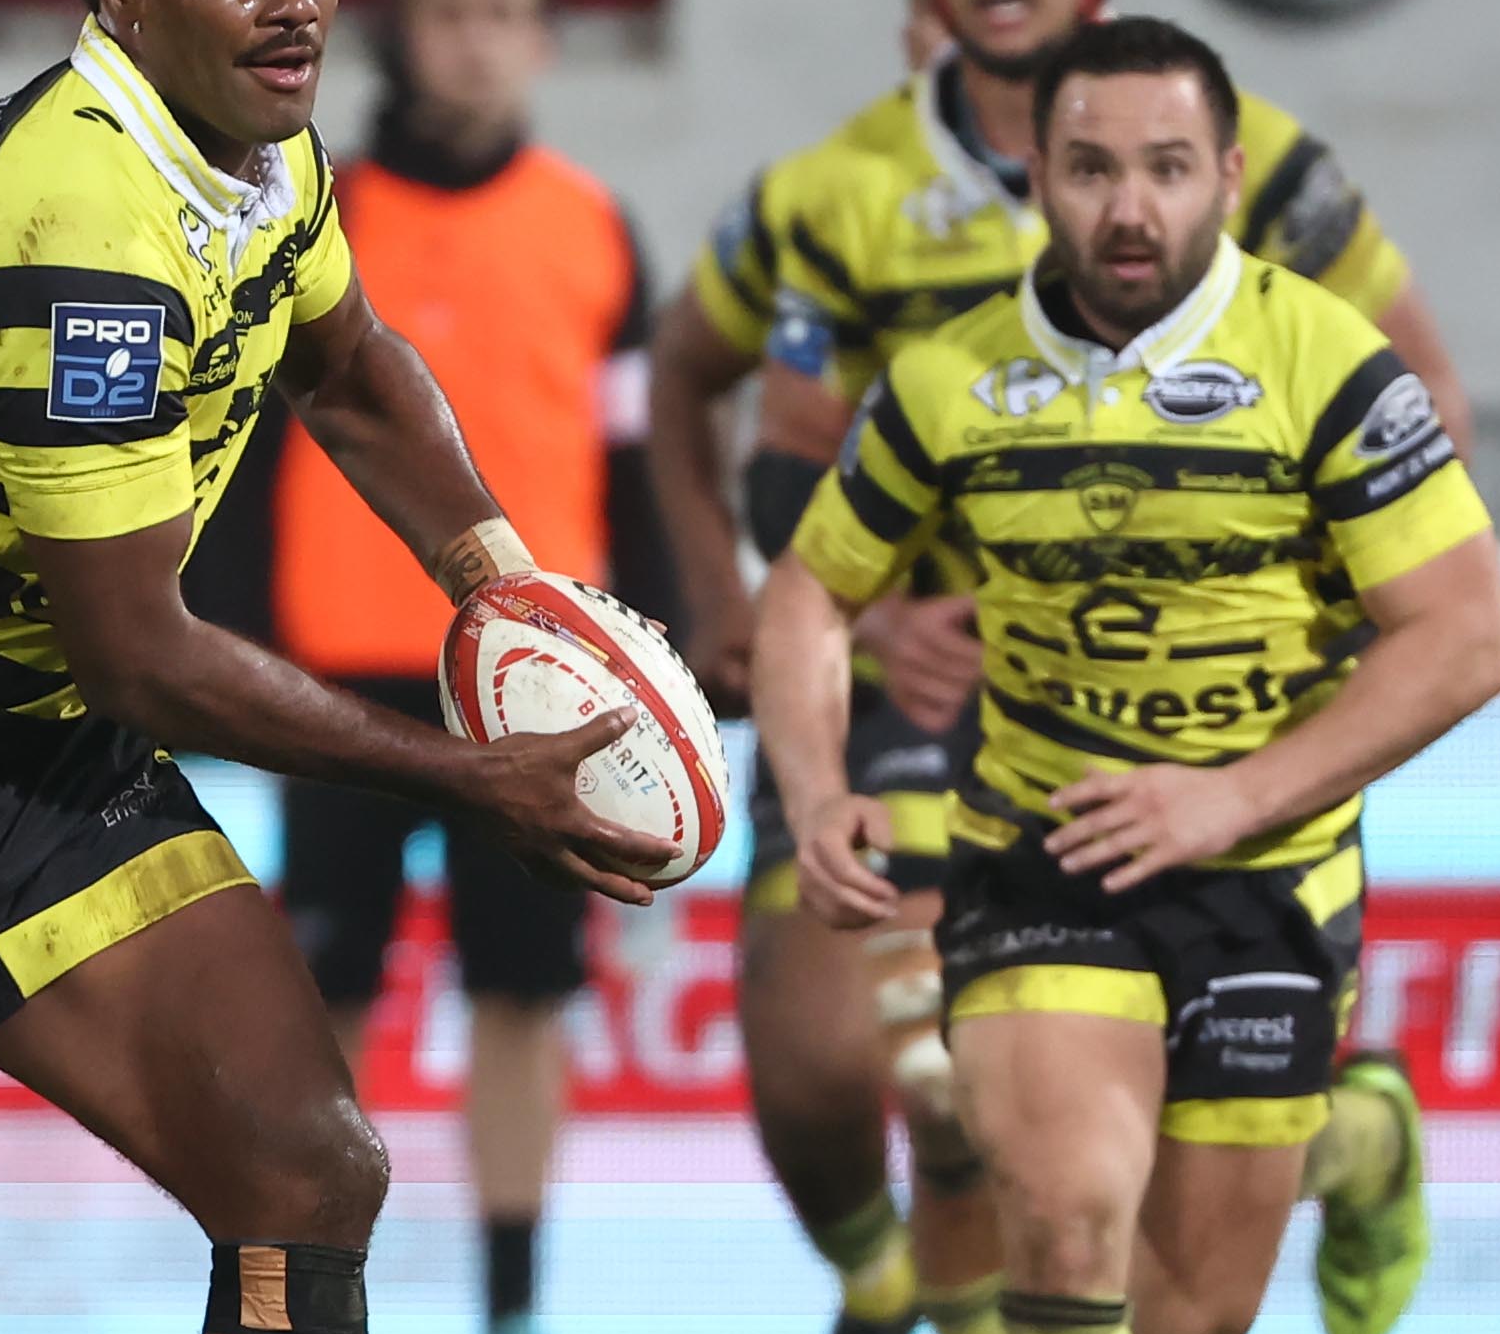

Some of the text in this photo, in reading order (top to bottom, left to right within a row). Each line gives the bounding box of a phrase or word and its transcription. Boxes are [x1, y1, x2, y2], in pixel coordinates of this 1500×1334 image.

[66, 318, 151, 344] PRO
[62, 369, 145, 405] D2
[578, 698, 659, 796] BRRITZ
